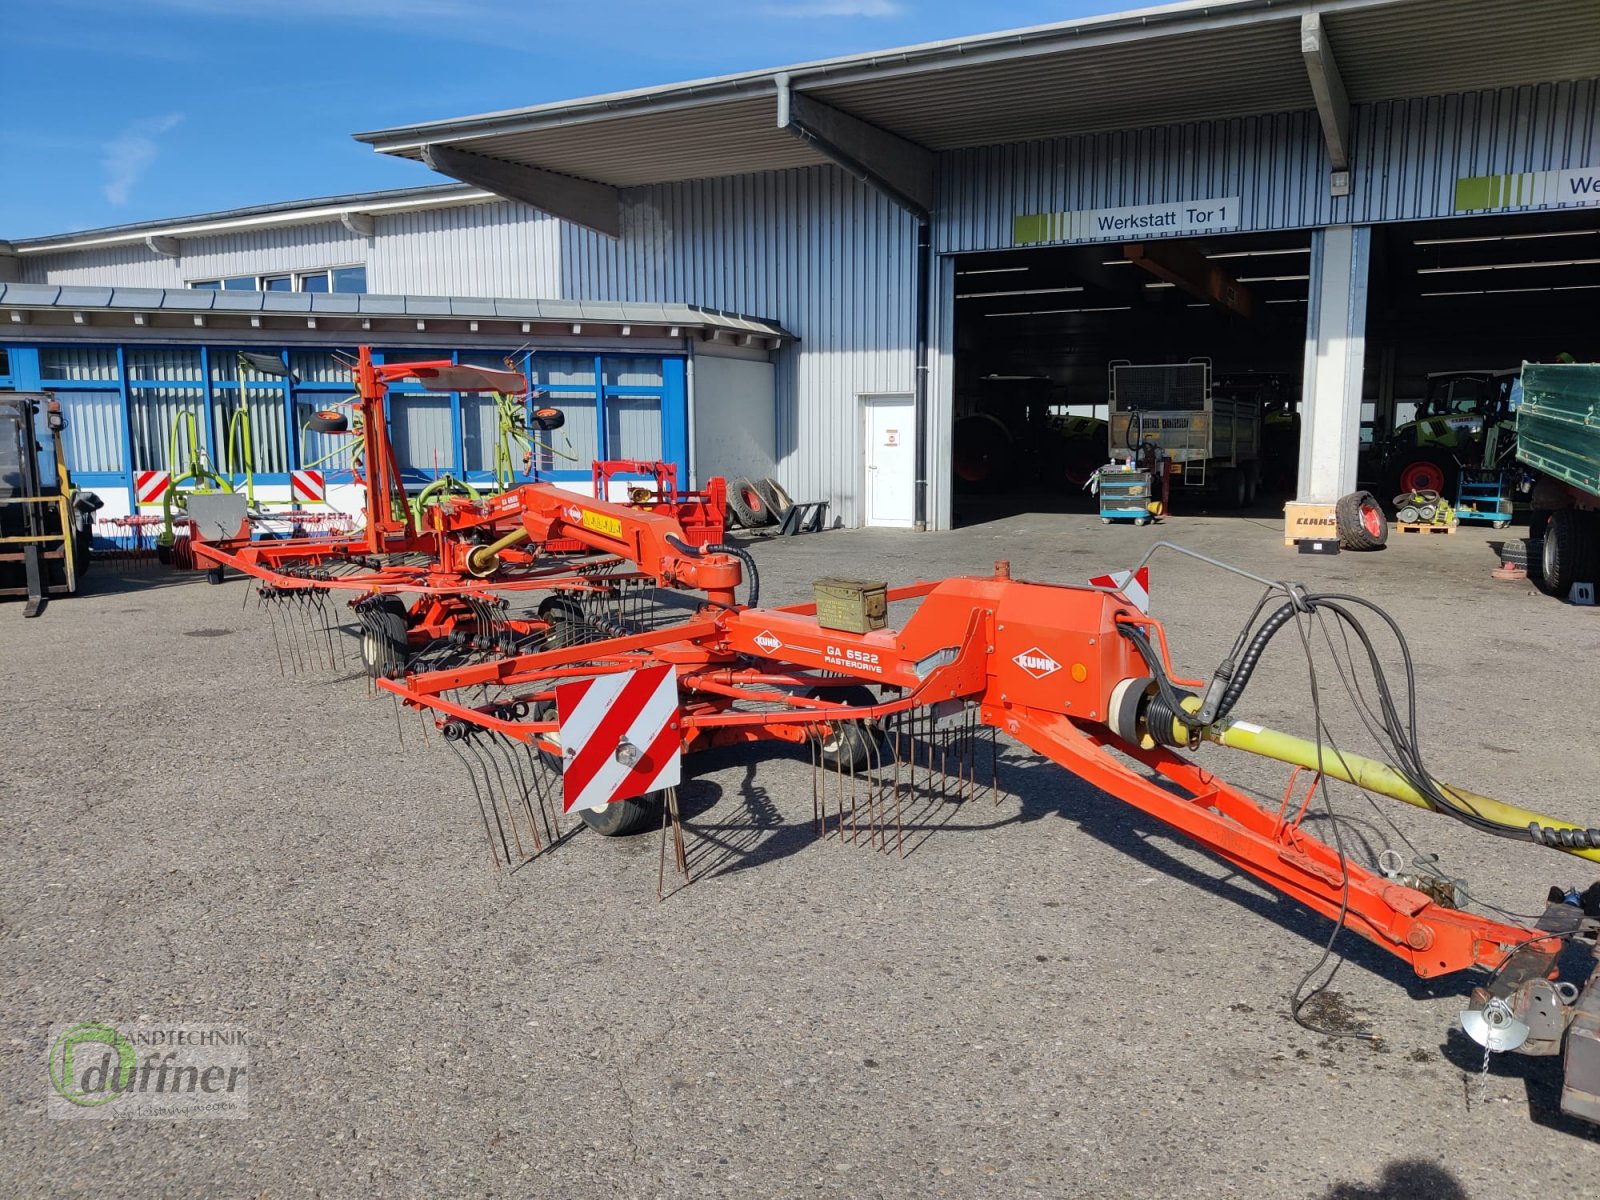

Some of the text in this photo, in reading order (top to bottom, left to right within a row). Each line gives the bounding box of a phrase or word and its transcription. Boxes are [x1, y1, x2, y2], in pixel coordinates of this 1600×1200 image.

[1098, 206, 1227, 230] Werkstatt Tor 1
[1296, 518, 1336, 526] CLAAS
[758, 636, 779, 648] KUHN
[826, 645, 879, 664] GA 6522
[824, 656, 882, 673] MASTERDRIVE
[1019, 655, 1055, 671] KUHN
